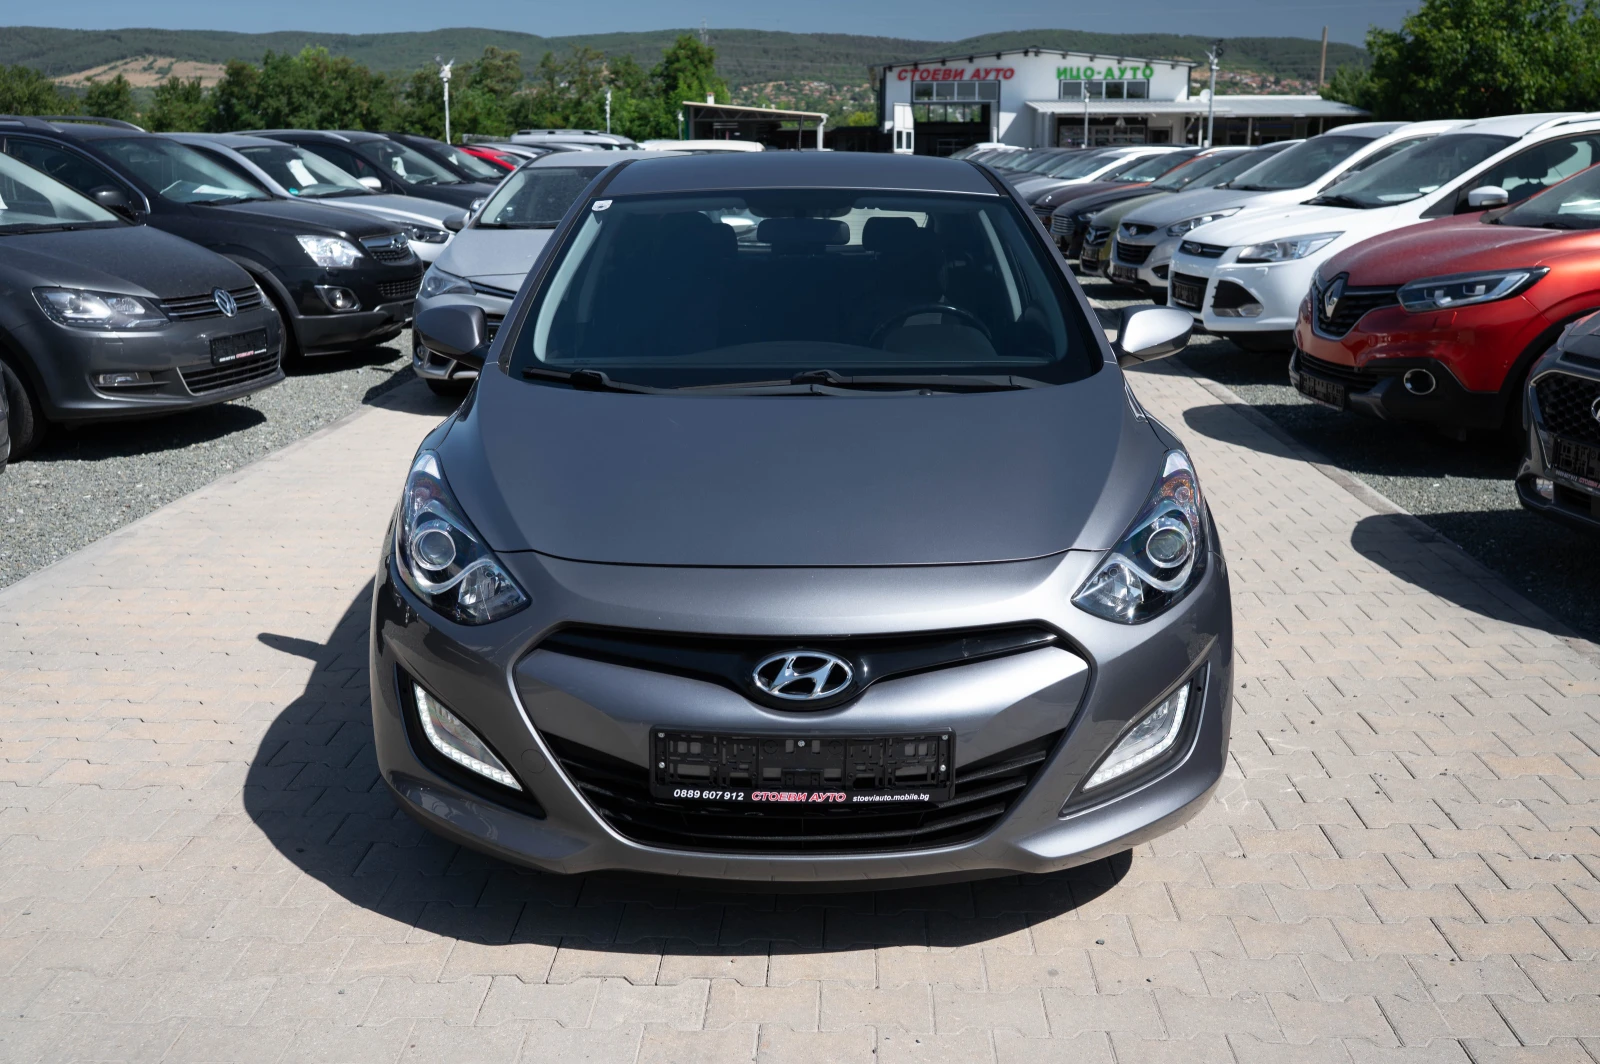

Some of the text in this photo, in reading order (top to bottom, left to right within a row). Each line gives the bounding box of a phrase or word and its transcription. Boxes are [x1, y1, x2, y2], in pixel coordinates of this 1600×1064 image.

[897, 67, 1015, 81] СТОЕВИ АУТО
[1056, 66, 1154, 80] ИЦО-АУТО
[673, 788, 930, 803] 0889 607 912 СТОЕВИ АУТО stoeviauto.mobile.bg
